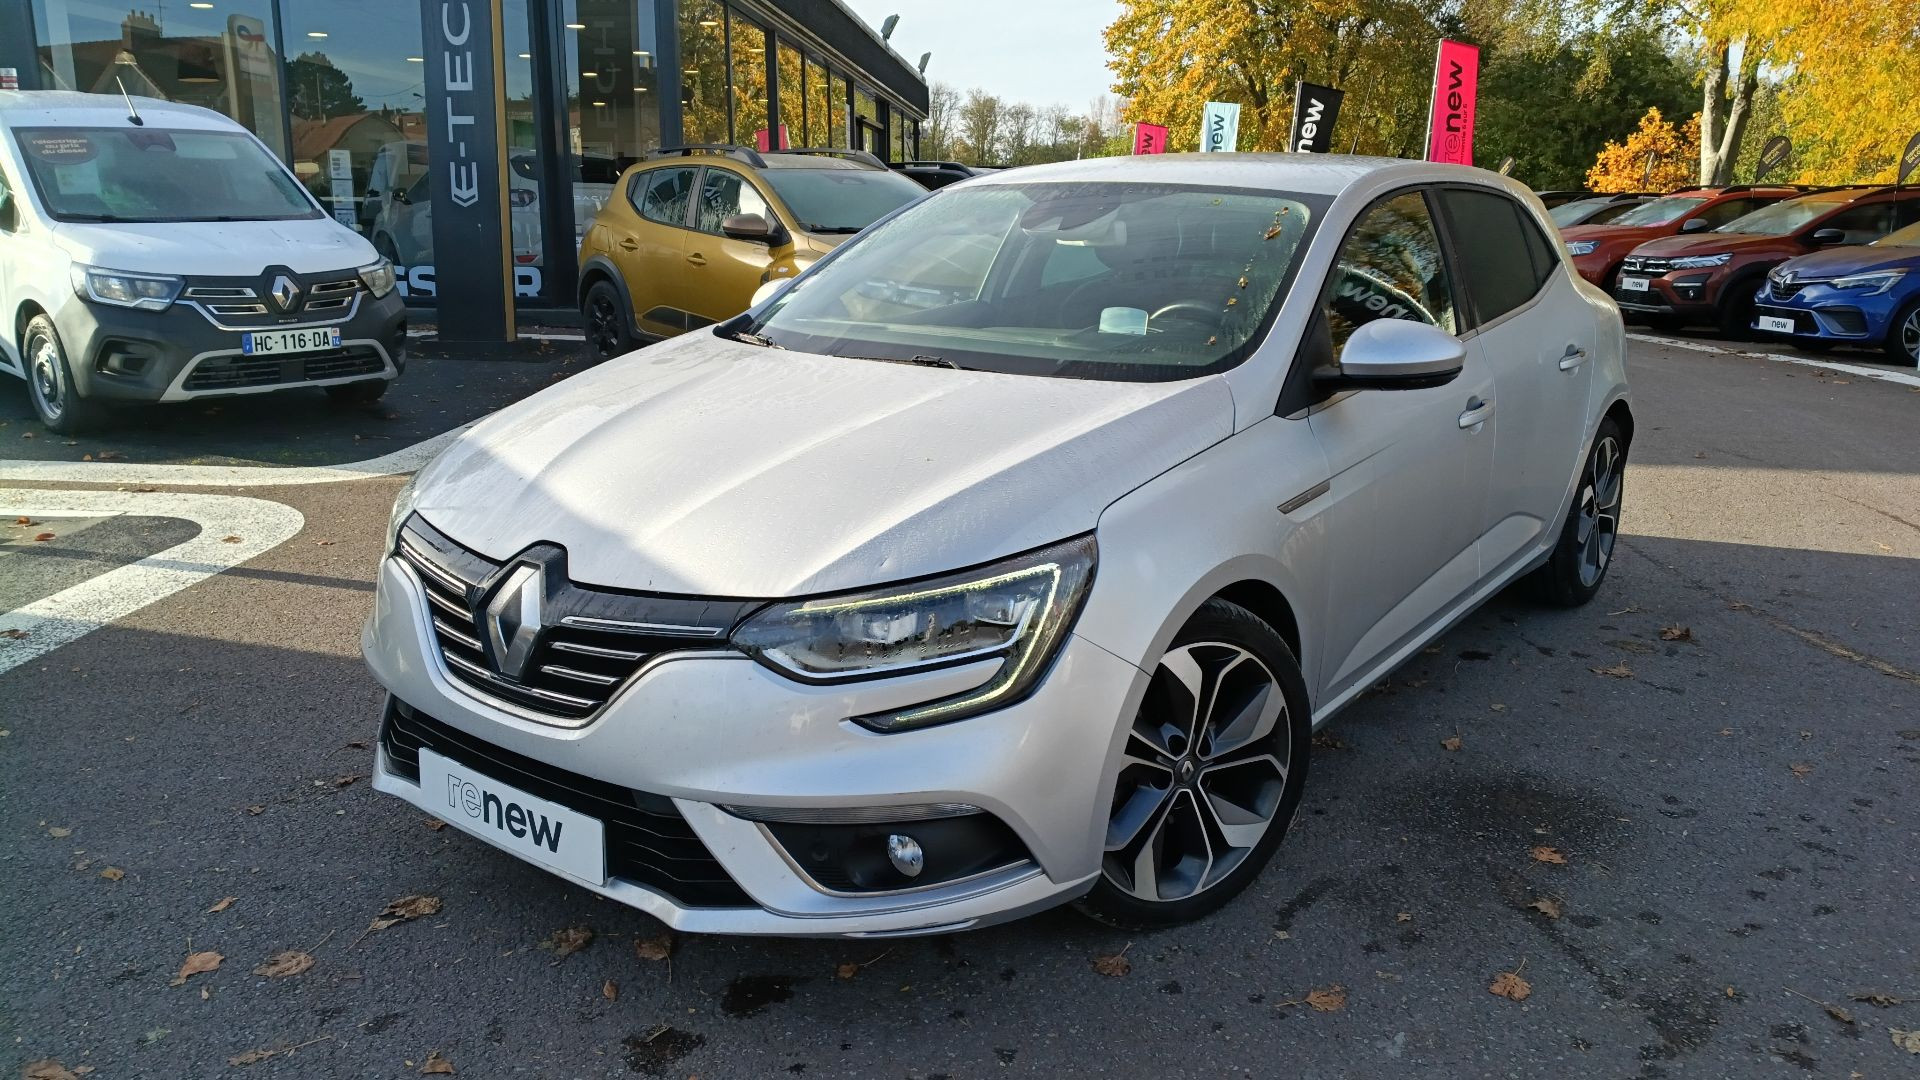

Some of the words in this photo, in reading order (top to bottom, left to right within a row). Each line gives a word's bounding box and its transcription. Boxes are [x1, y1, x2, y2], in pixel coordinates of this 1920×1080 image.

[1297, 98, 1325, 153] new
[254, 331, 330, 352] HC-116-DA
[1771, 320, 1787, 329] new
[447, 773, 563, 853] renew
